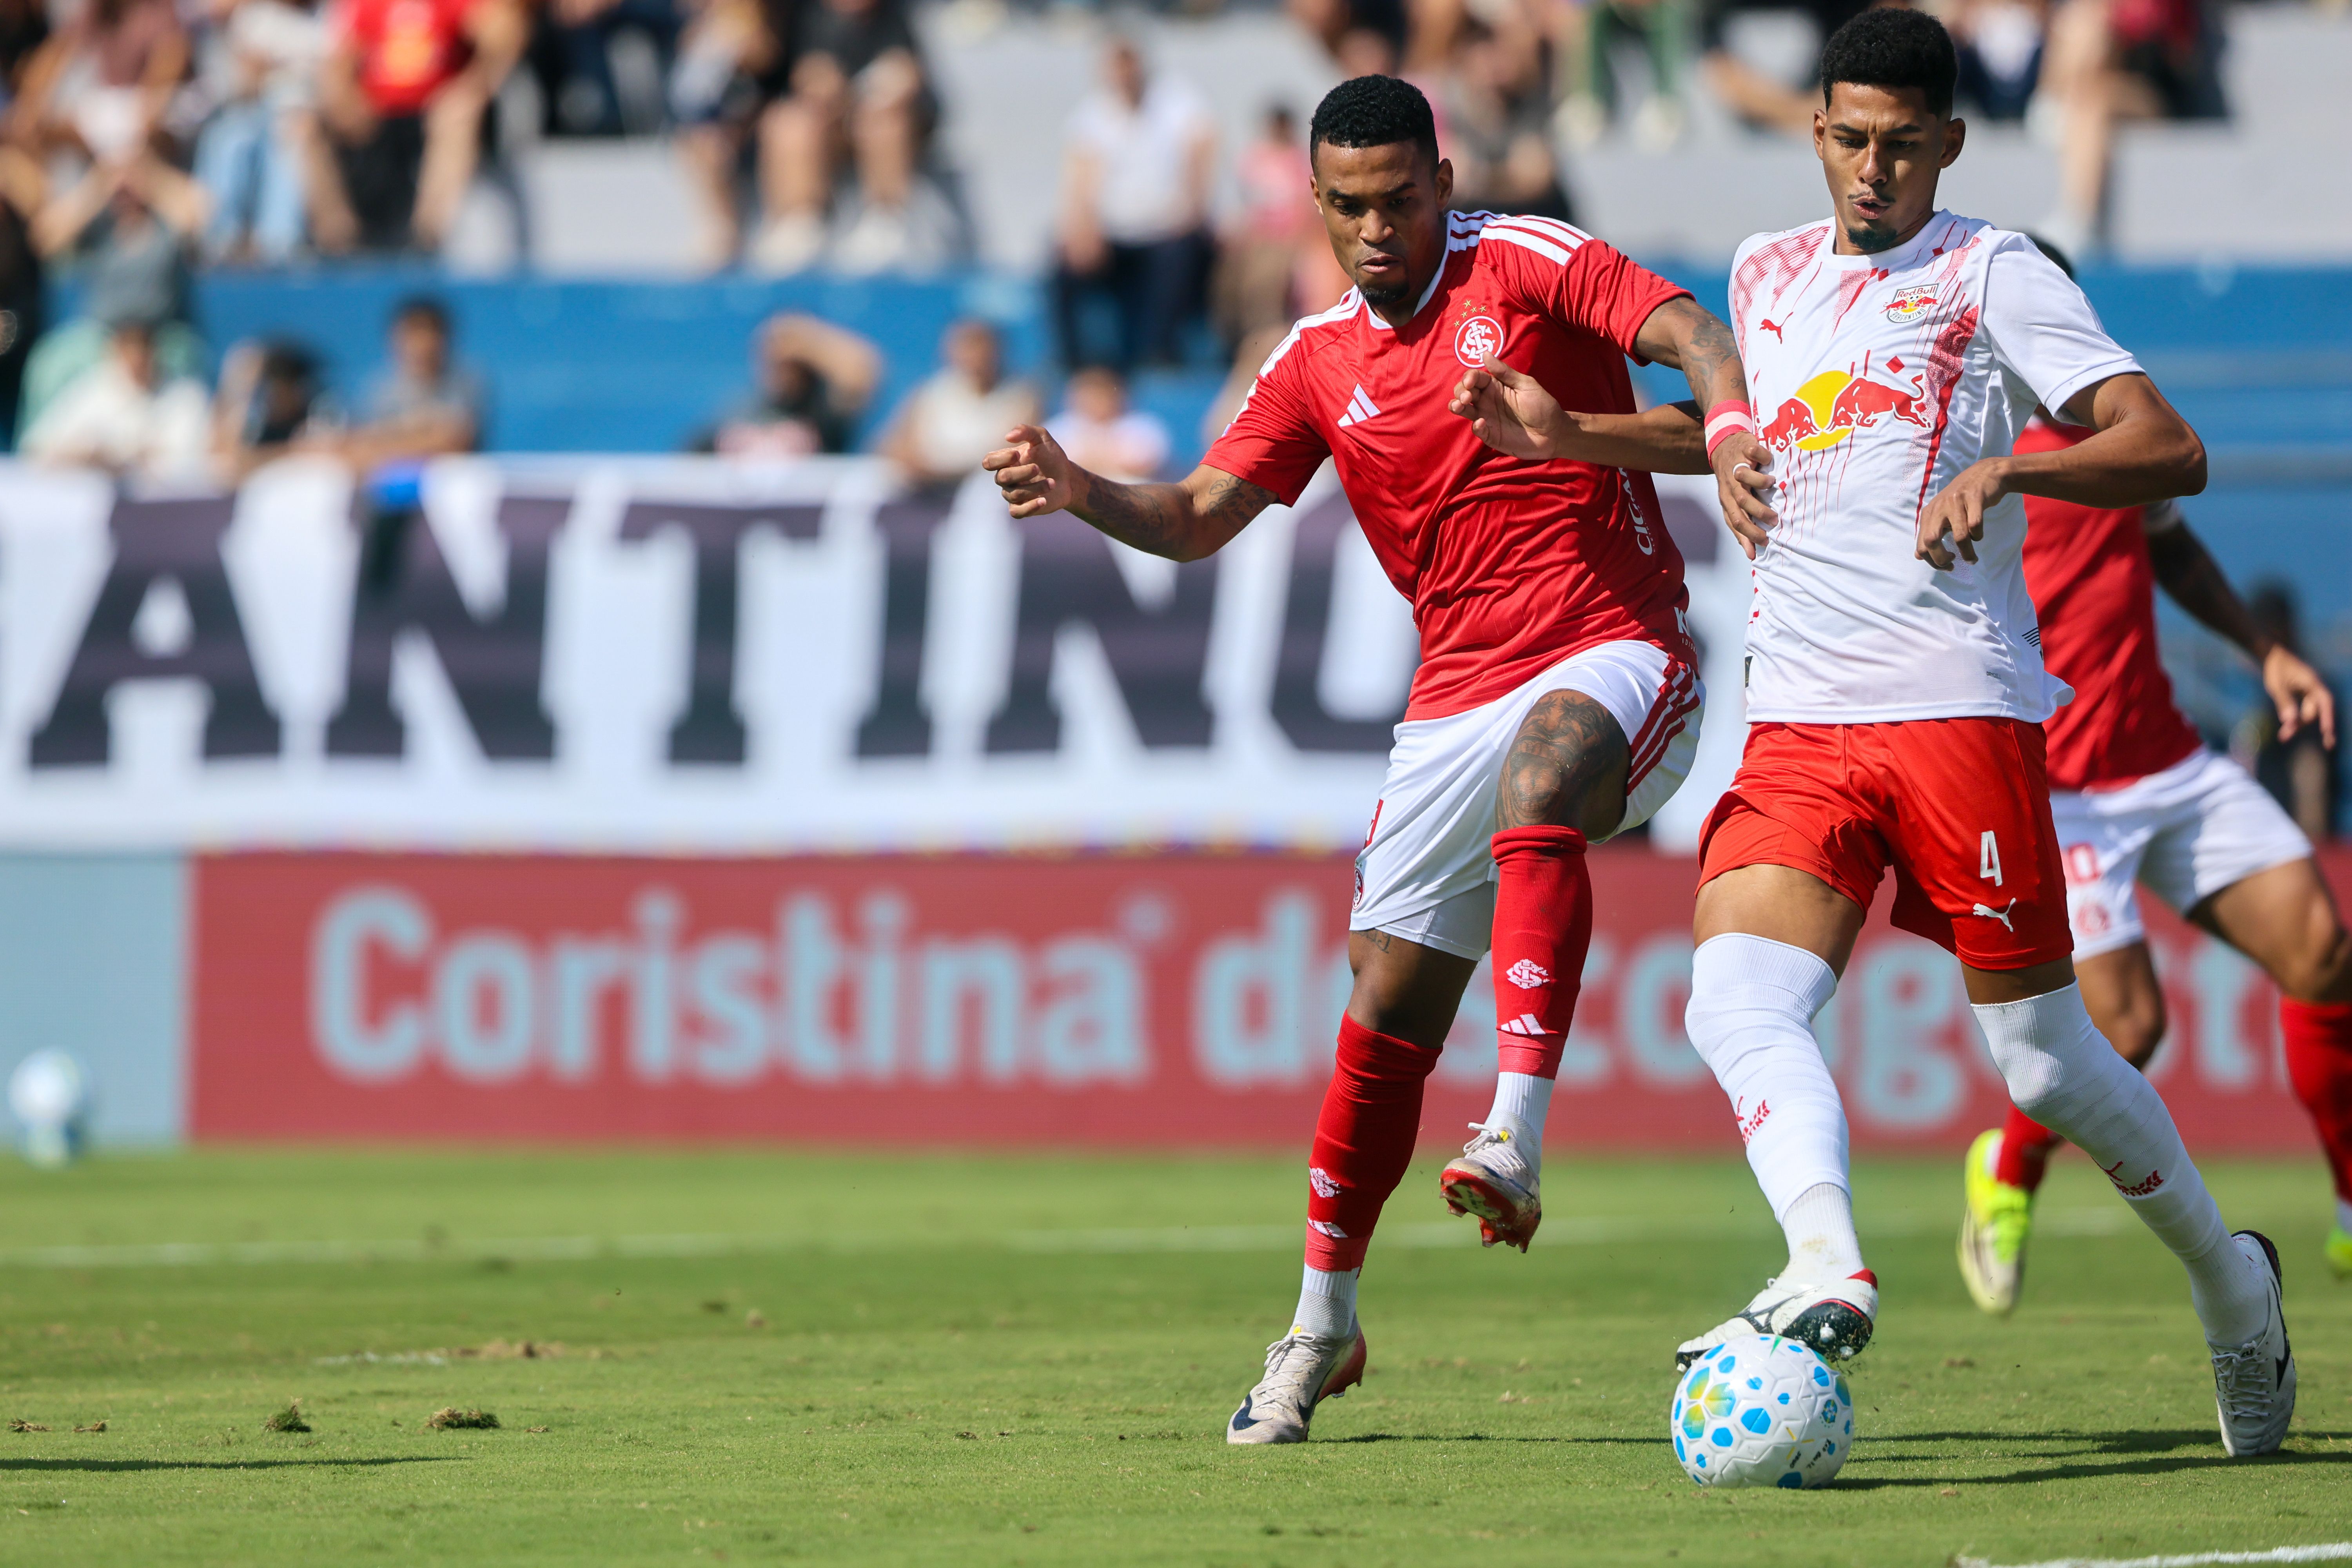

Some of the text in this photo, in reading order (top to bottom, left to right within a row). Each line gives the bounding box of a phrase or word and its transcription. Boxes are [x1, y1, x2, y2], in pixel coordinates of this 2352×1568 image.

[1897, 286, 1936, 298] Red Bull
[1890, 308, 1926, 321] BRAGANTINO
[1618, 467, 1653, 555] CIGA
[27, 486, 1721, 766] ANTINO
[1674, 606, 1691, 638] K
[1682, 637, 1697, 654] IDIOM
[1980, 830, 2003, 886] 4
